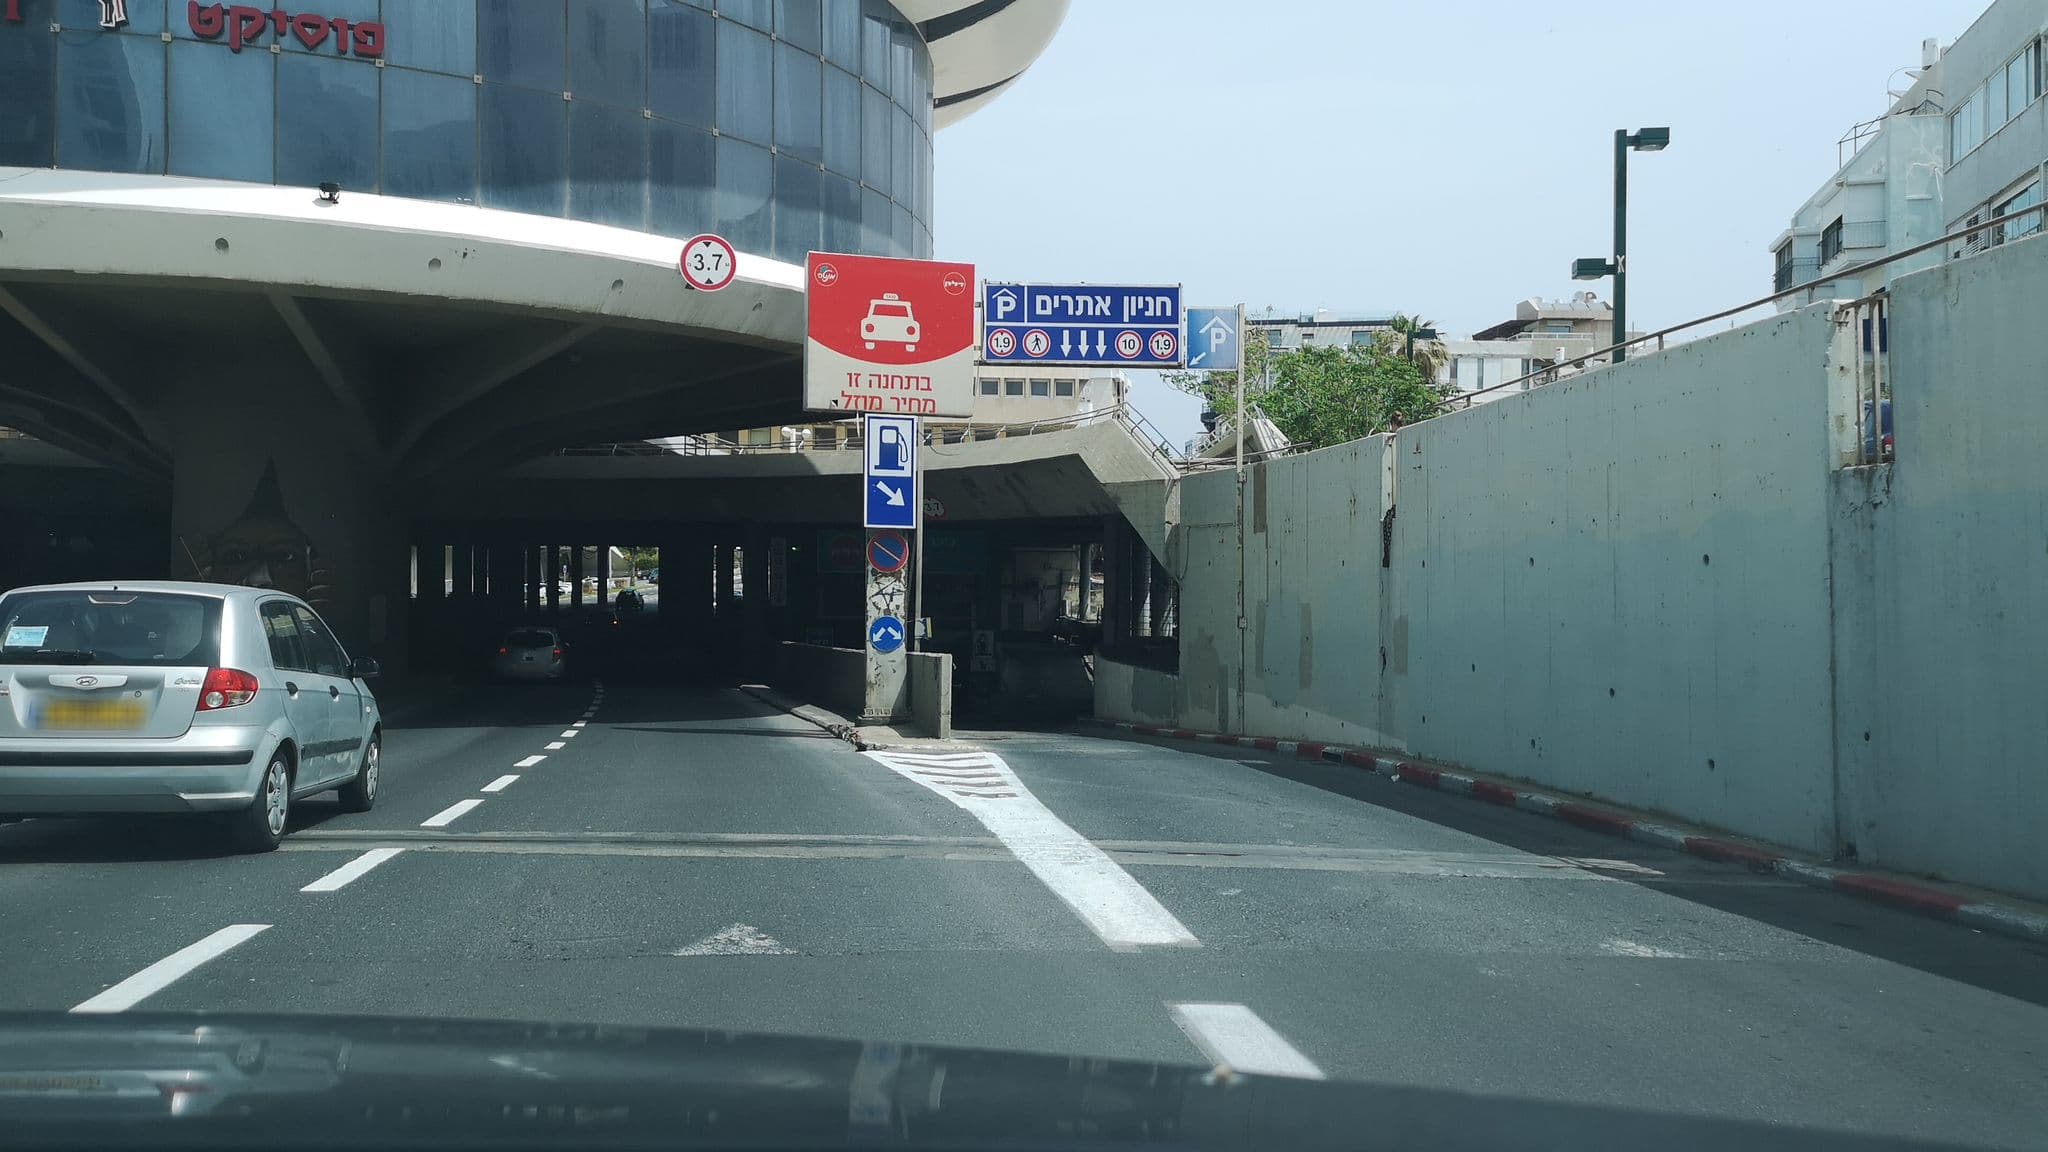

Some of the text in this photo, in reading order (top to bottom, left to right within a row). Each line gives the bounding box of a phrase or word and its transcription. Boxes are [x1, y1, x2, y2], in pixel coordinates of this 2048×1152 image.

[188, 1, 385, 57] פוסיקט
[693, 253, 723, 271] 3.7
[1035, 294, 1172, 323] חניון אתרים
[994, 338, 1010, 348] 1.9
[1122, 338, 1136, 350] 10
[1155, 339, 1171, 350] 1.9
[847, 372, 932, 391] בתחנה זו
[841, 390, 936, 413] מחיר מוזל
